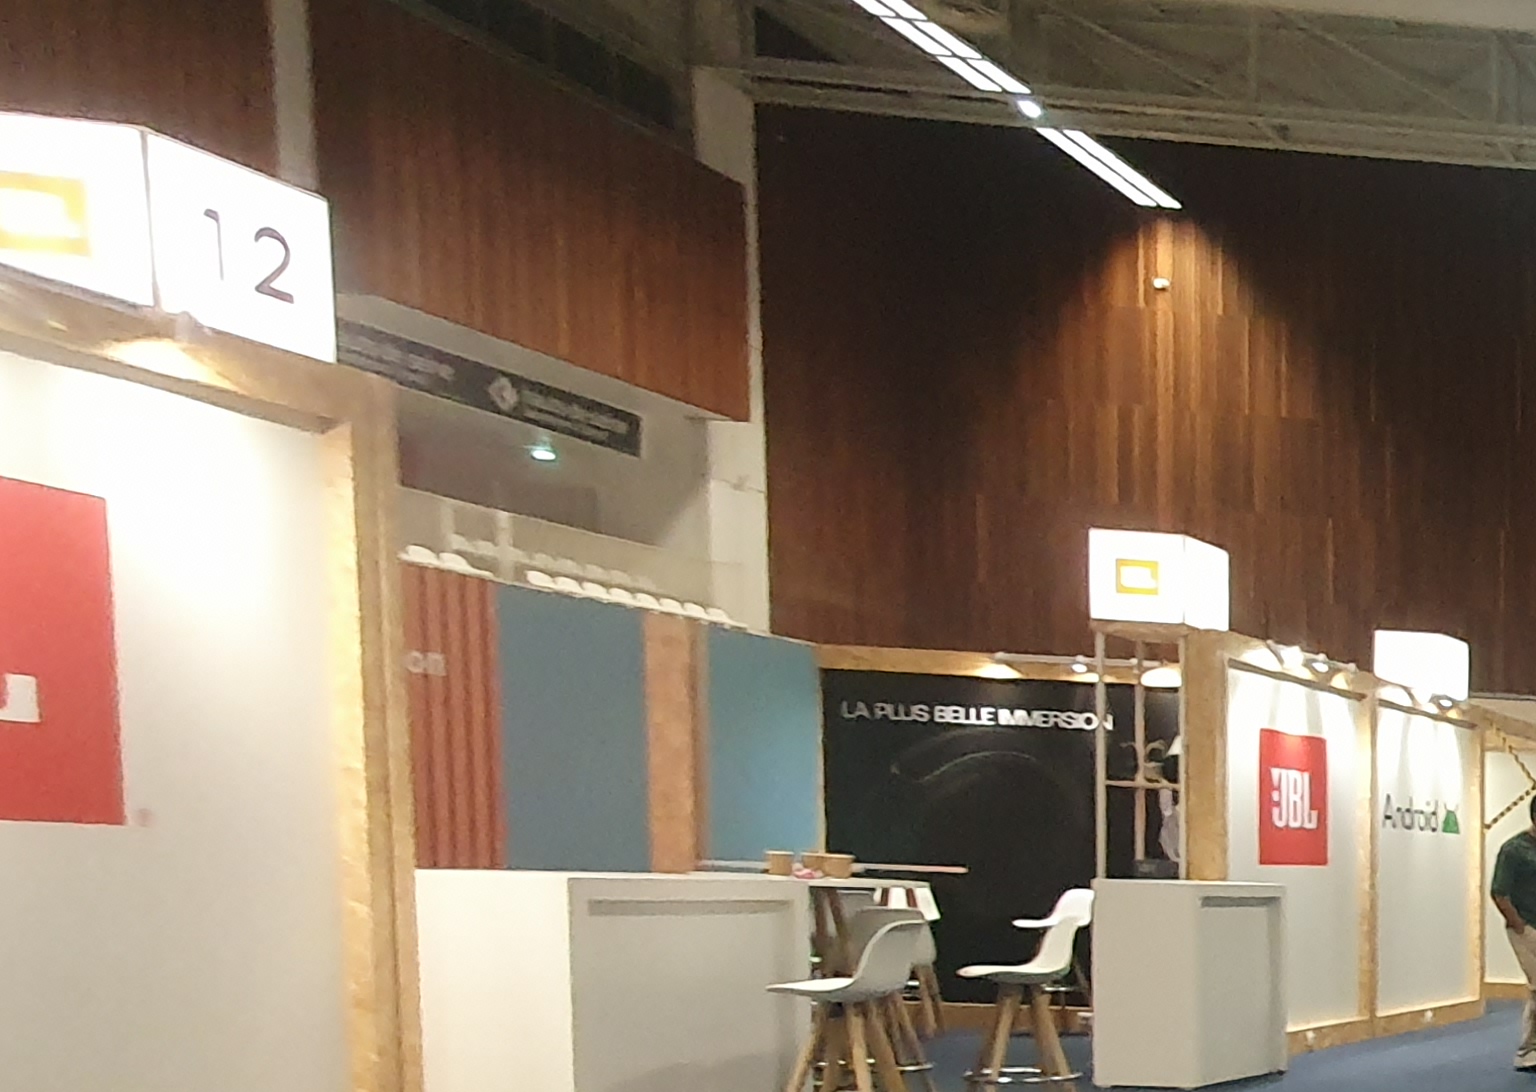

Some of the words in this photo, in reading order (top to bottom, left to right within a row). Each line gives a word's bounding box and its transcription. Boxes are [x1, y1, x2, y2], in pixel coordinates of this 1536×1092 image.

[203, 208, 295, 305] 12
[840, 700, 871, 720] LA
[873, 702, 931, 723] PLUS
[933, 704, 997, 727] BELLE
[997, 707, 1115, 732] IMMERSION
[1269, 766, 1319, 830] JBL
